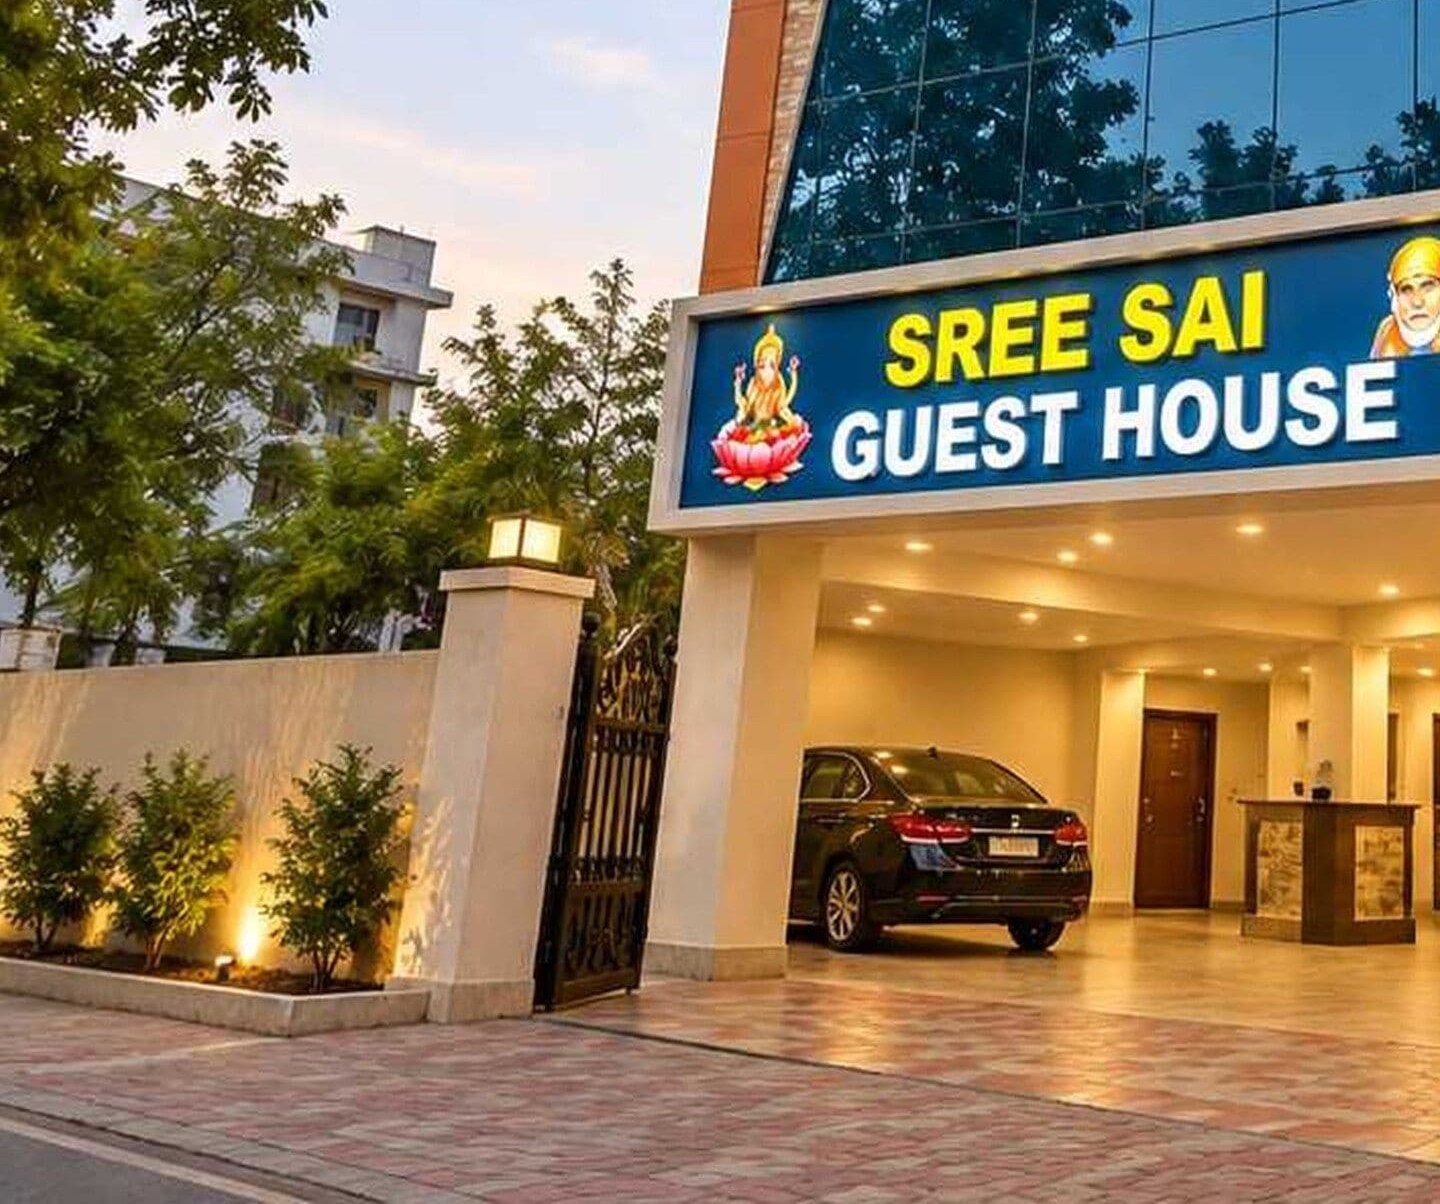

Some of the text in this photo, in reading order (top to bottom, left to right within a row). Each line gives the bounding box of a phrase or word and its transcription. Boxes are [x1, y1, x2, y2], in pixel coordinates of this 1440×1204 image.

[886, 271, 1265, 388] SREE SAI
[831, 362, 1398, 481] GUEST HOUSE
